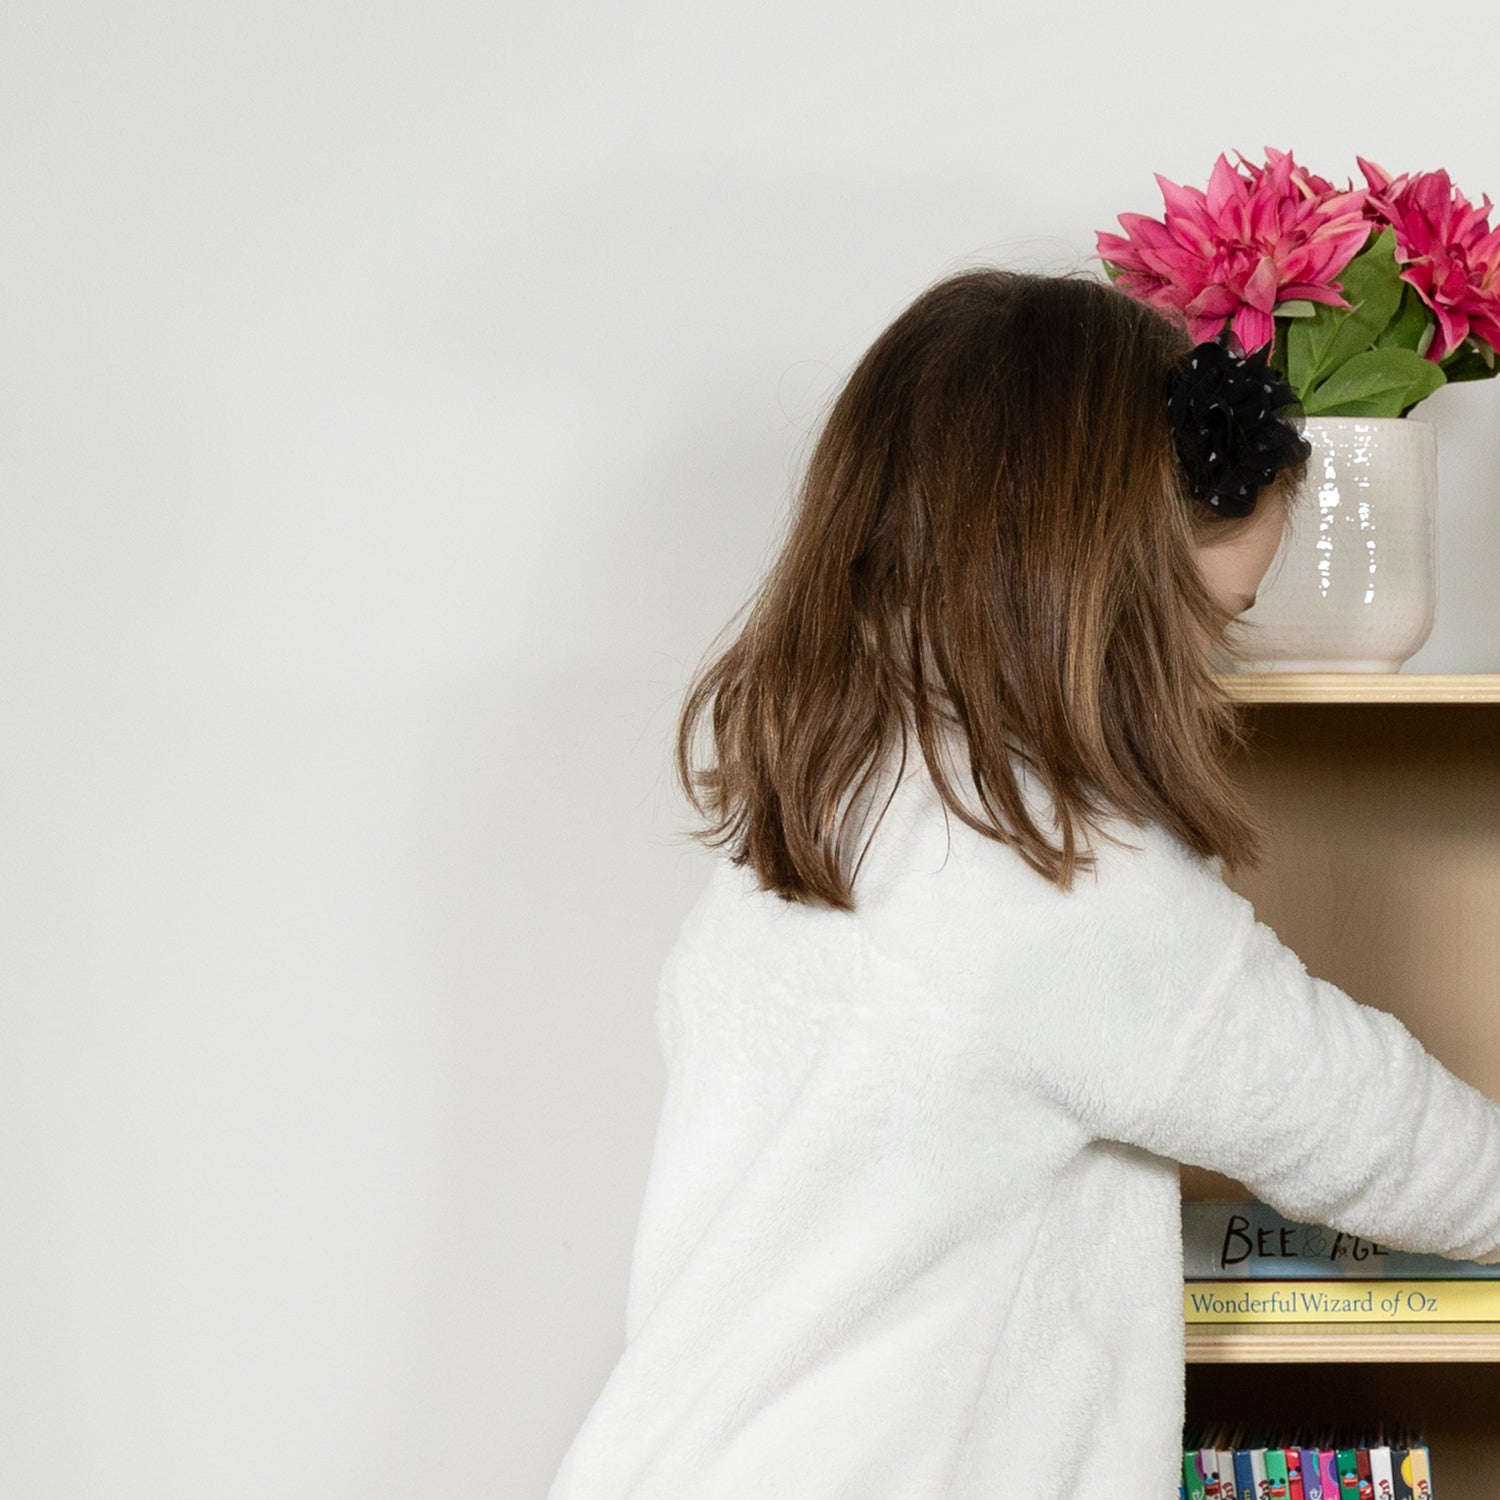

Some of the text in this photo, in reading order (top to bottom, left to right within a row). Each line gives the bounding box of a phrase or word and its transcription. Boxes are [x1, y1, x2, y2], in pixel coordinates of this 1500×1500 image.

[1221, 1215, 1299, 1270] BEE
[1191, 1291, 1438, 1317] Wonderful Wizard of Oz
